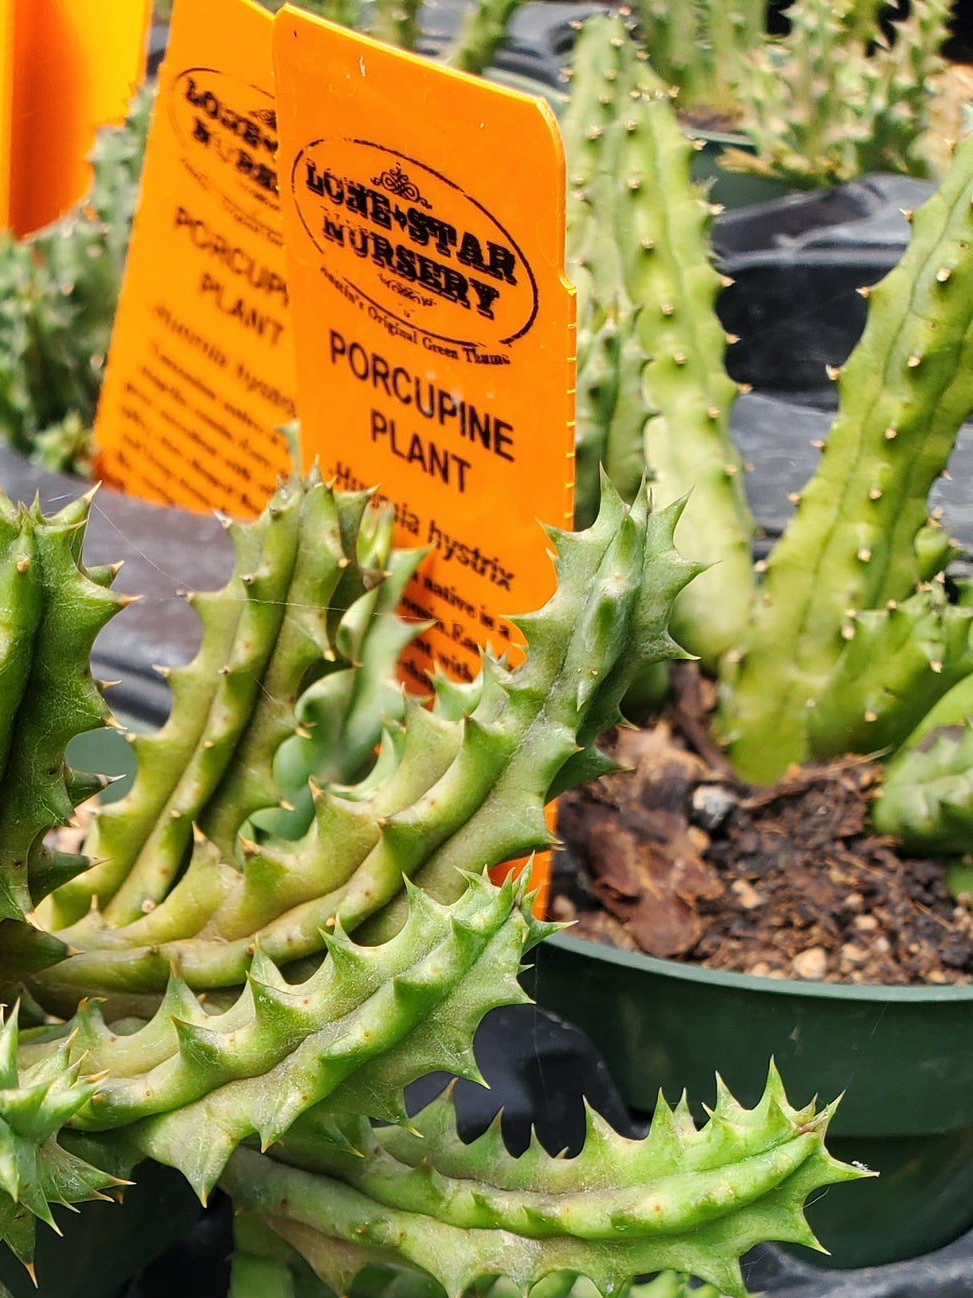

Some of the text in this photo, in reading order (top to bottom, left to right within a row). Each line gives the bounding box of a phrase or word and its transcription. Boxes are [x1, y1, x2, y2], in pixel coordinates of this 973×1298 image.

[321, 209, 500, 321] NURSERY
[406, 207, 518, 287] STAR
[202, 273, 283, 347] PLANT
[368, 306, 417, 345] Original
[422, 336, 459, 360] Green
[329, 329, 515, 462] PORCUPINE
[370, 408, 472, 493] PLANT
[428, 520, 514, 591] hystrix
